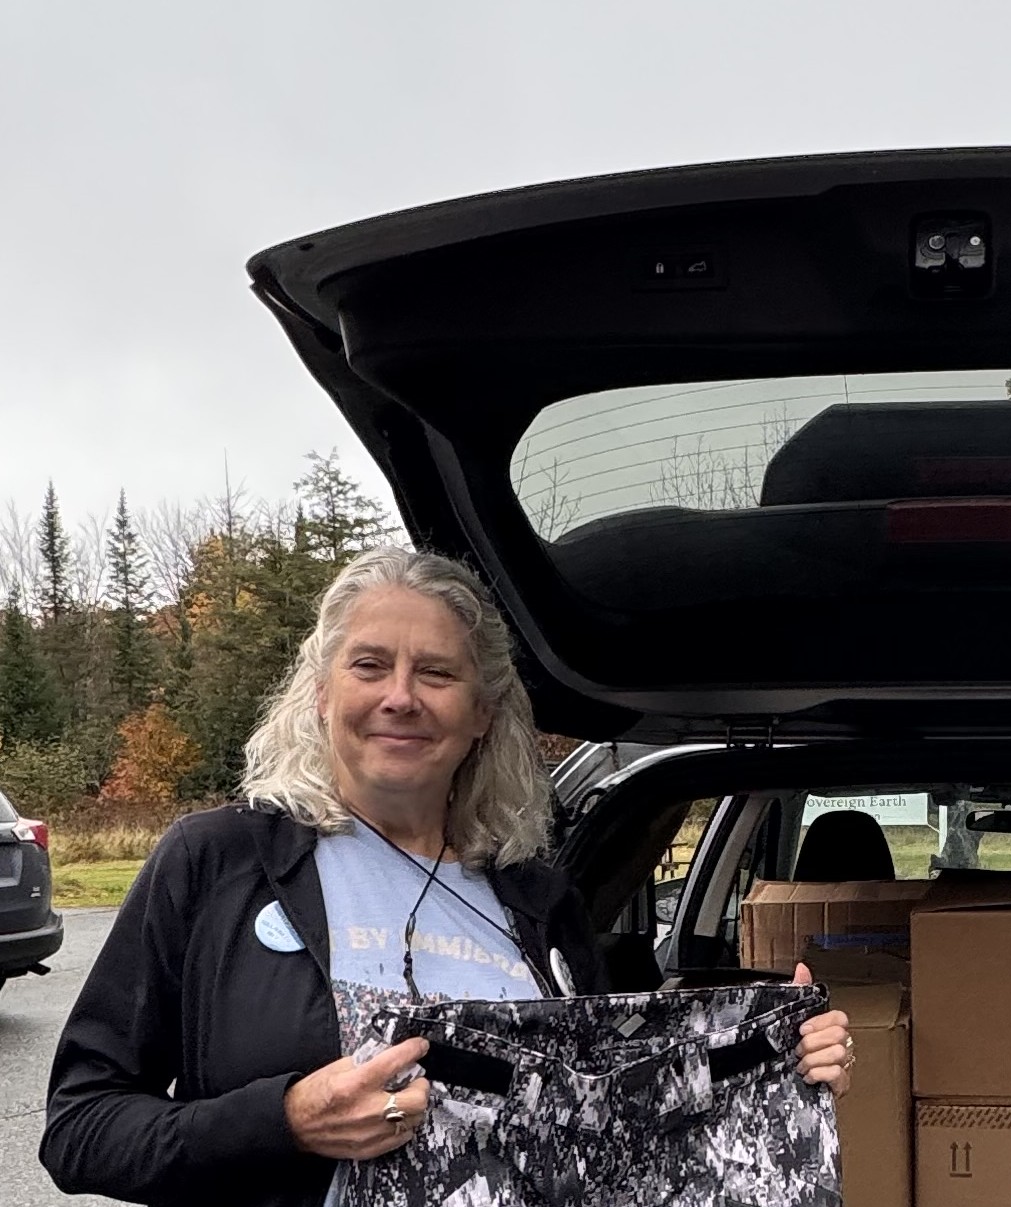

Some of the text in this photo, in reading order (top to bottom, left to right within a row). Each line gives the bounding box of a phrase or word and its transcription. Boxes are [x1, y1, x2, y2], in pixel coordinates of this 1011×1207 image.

[806, 796, 907, 810] overeign Earth
[349, 926, 388, 950] BY
